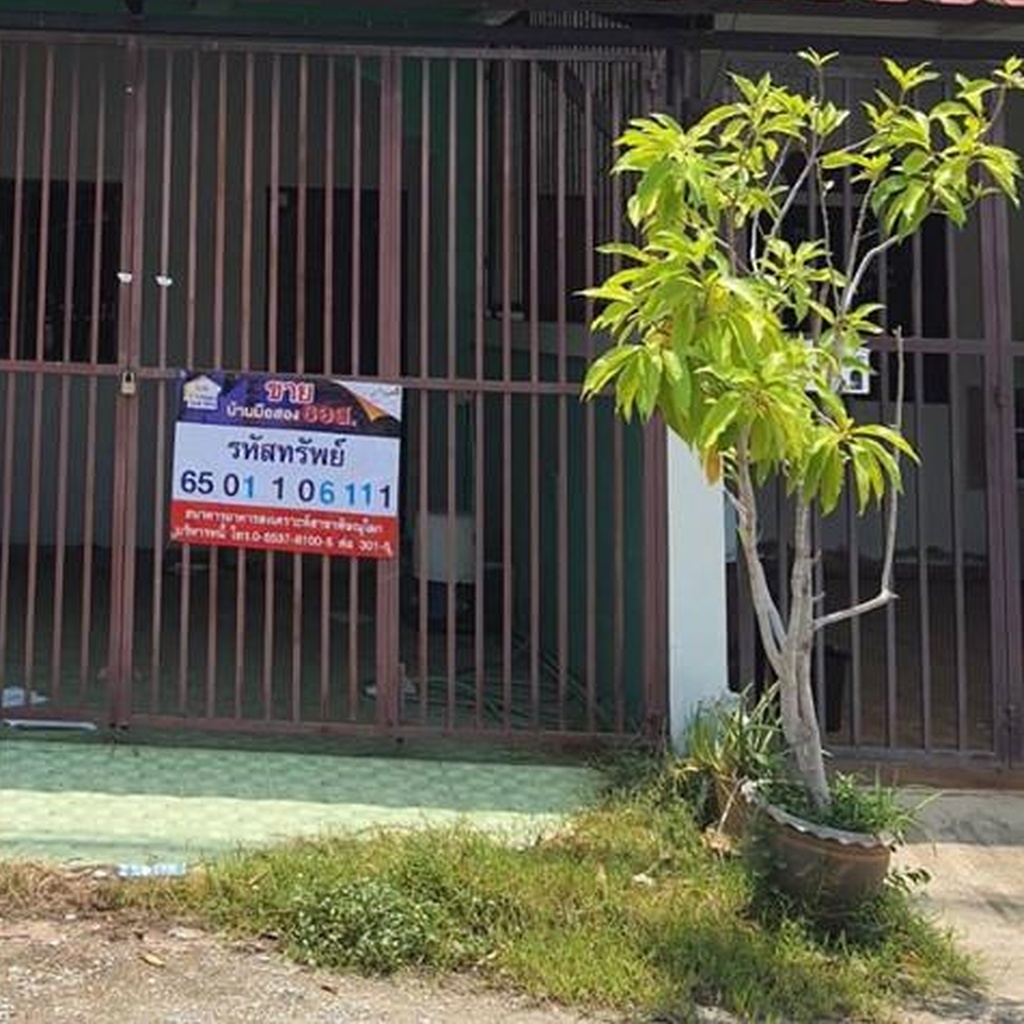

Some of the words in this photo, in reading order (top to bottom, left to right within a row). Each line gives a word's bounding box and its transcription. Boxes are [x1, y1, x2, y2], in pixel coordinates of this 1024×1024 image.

[265, 380, 315, 404] ขาย
[227, 402, 299, 421] บ้านมือสอง
[228, 433, 347, 468] รหัสทรัพย์
